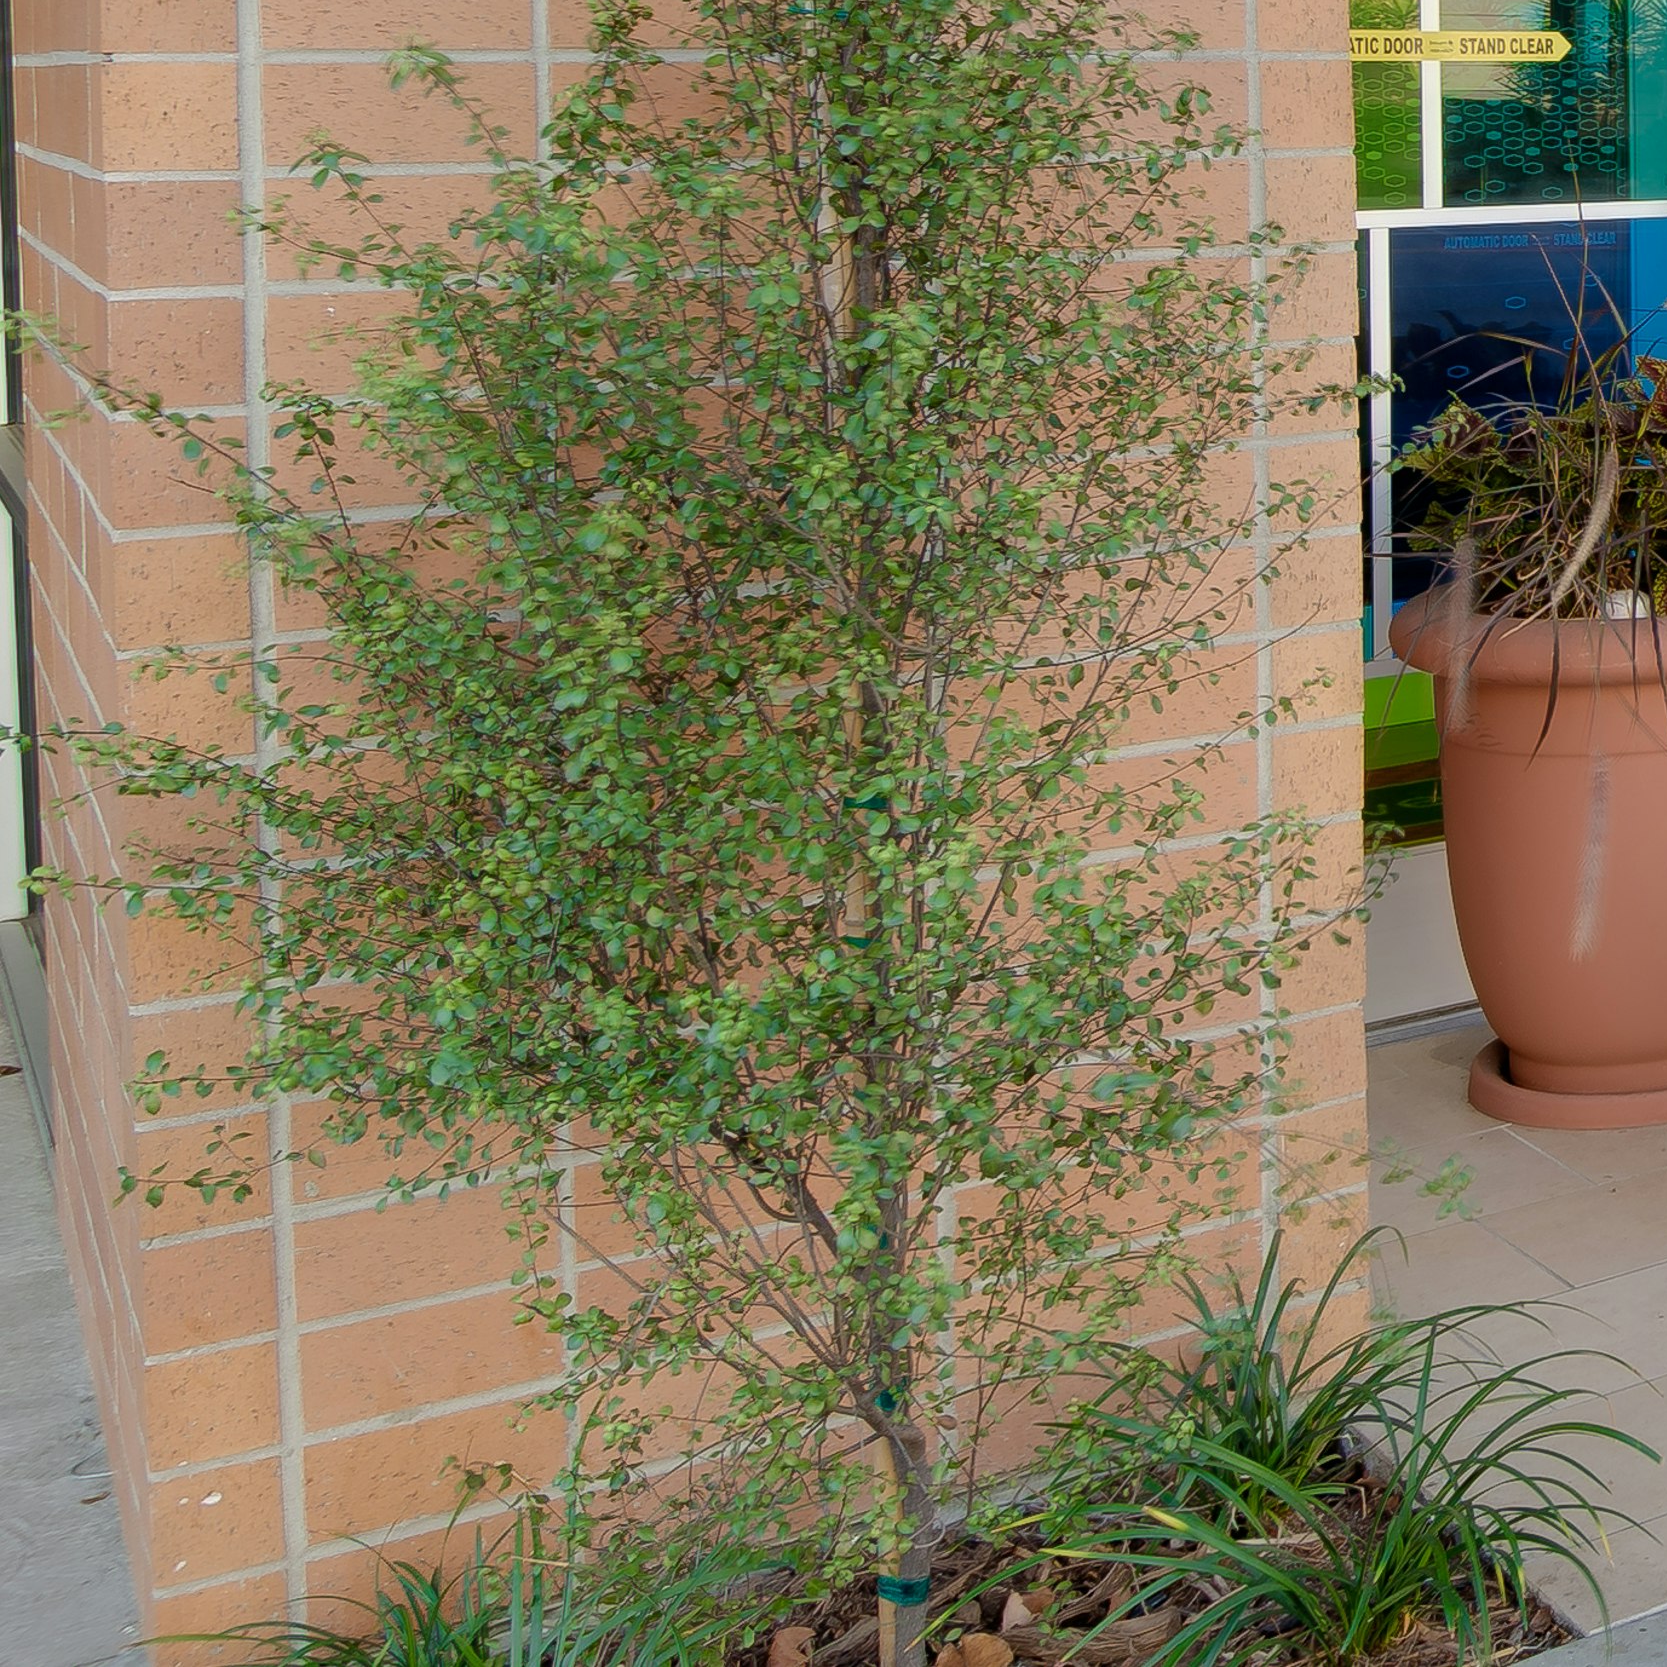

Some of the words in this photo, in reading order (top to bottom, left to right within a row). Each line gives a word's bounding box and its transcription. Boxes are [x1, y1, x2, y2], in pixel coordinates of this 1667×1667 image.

[1383, 37, 1425, 55] DOOR
[1459, 37, 1507, 55] STAND
[1509, 37, 1555, 55] CLEAR
